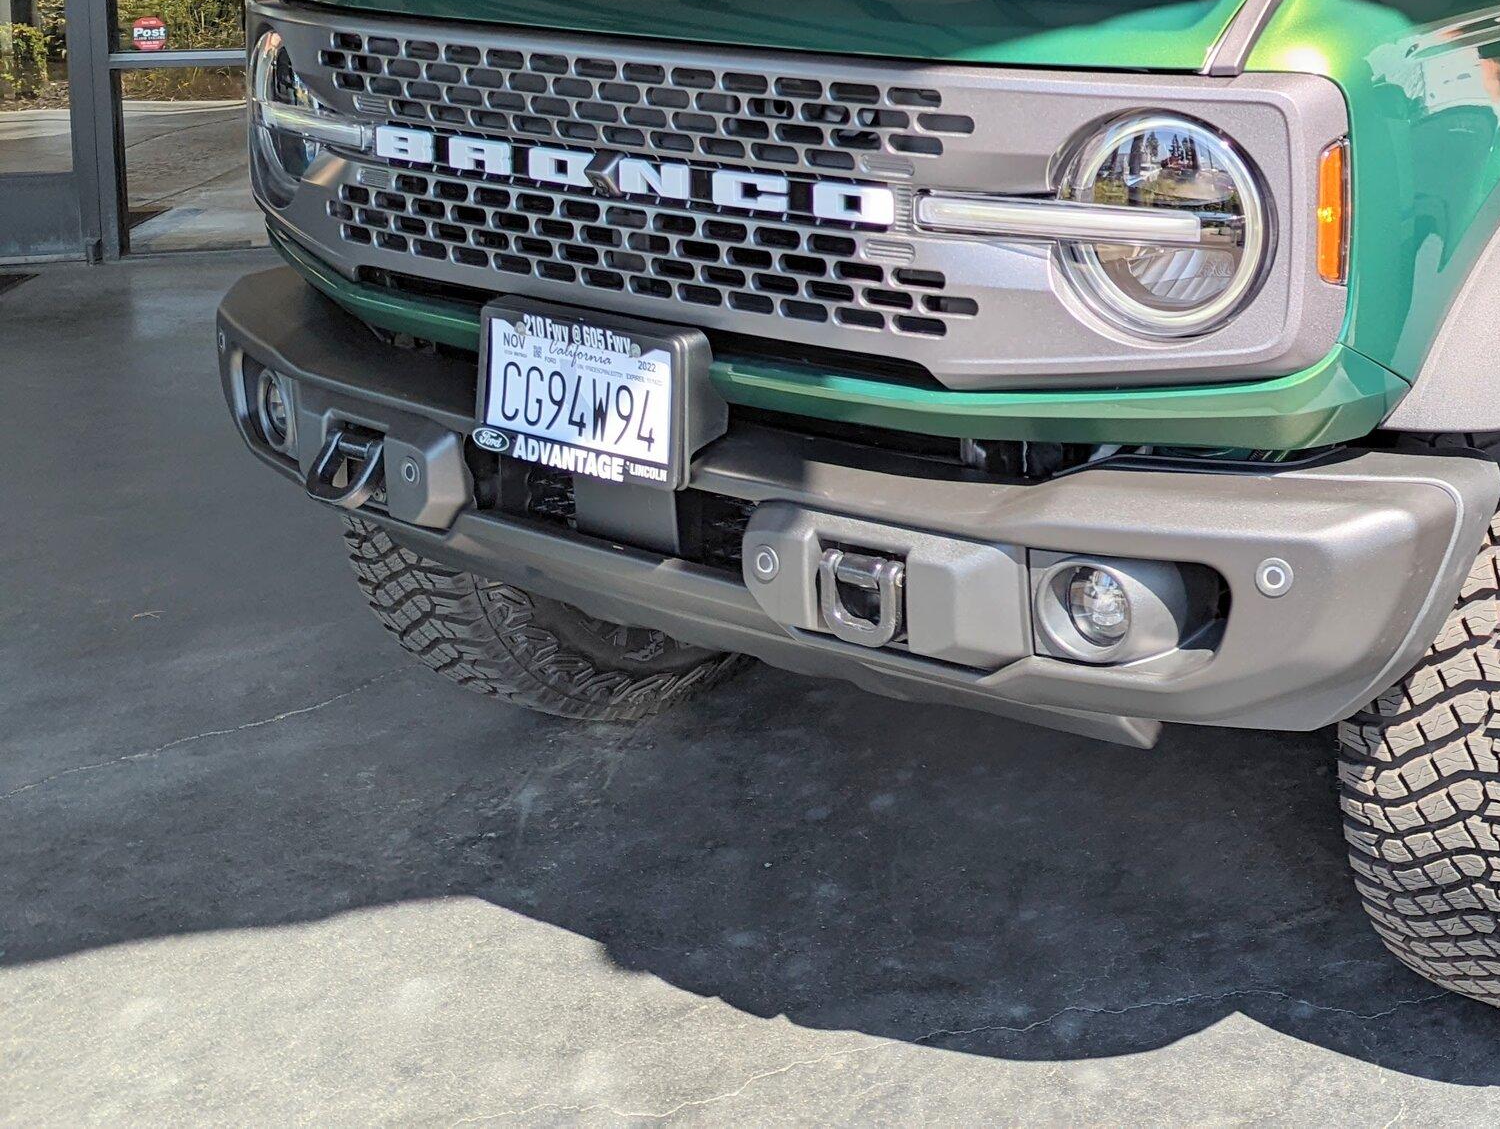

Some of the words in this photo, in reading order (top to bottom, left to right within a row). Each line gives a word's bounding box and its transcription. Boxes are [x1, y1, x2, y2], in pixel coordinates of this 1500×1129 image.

[133, 26, 166, 38] Post
[375, 124, 895, 226] BRONCO
[503, 332, 526, 349] NOV
[523, 313, 545, 338] 210
[572, 324, 582, 344] @
[583, 325, 605, 350] 605
[549, 341, 612, 368] California
[637, 360, 657, 373] 2022
[501, 361, 655, 452] CG94W94
[478, 430, 504, 449] Ford
[513, 434, 625, 483] ADVANTAGE
[629, 464, 668, 482] LINCOLN
